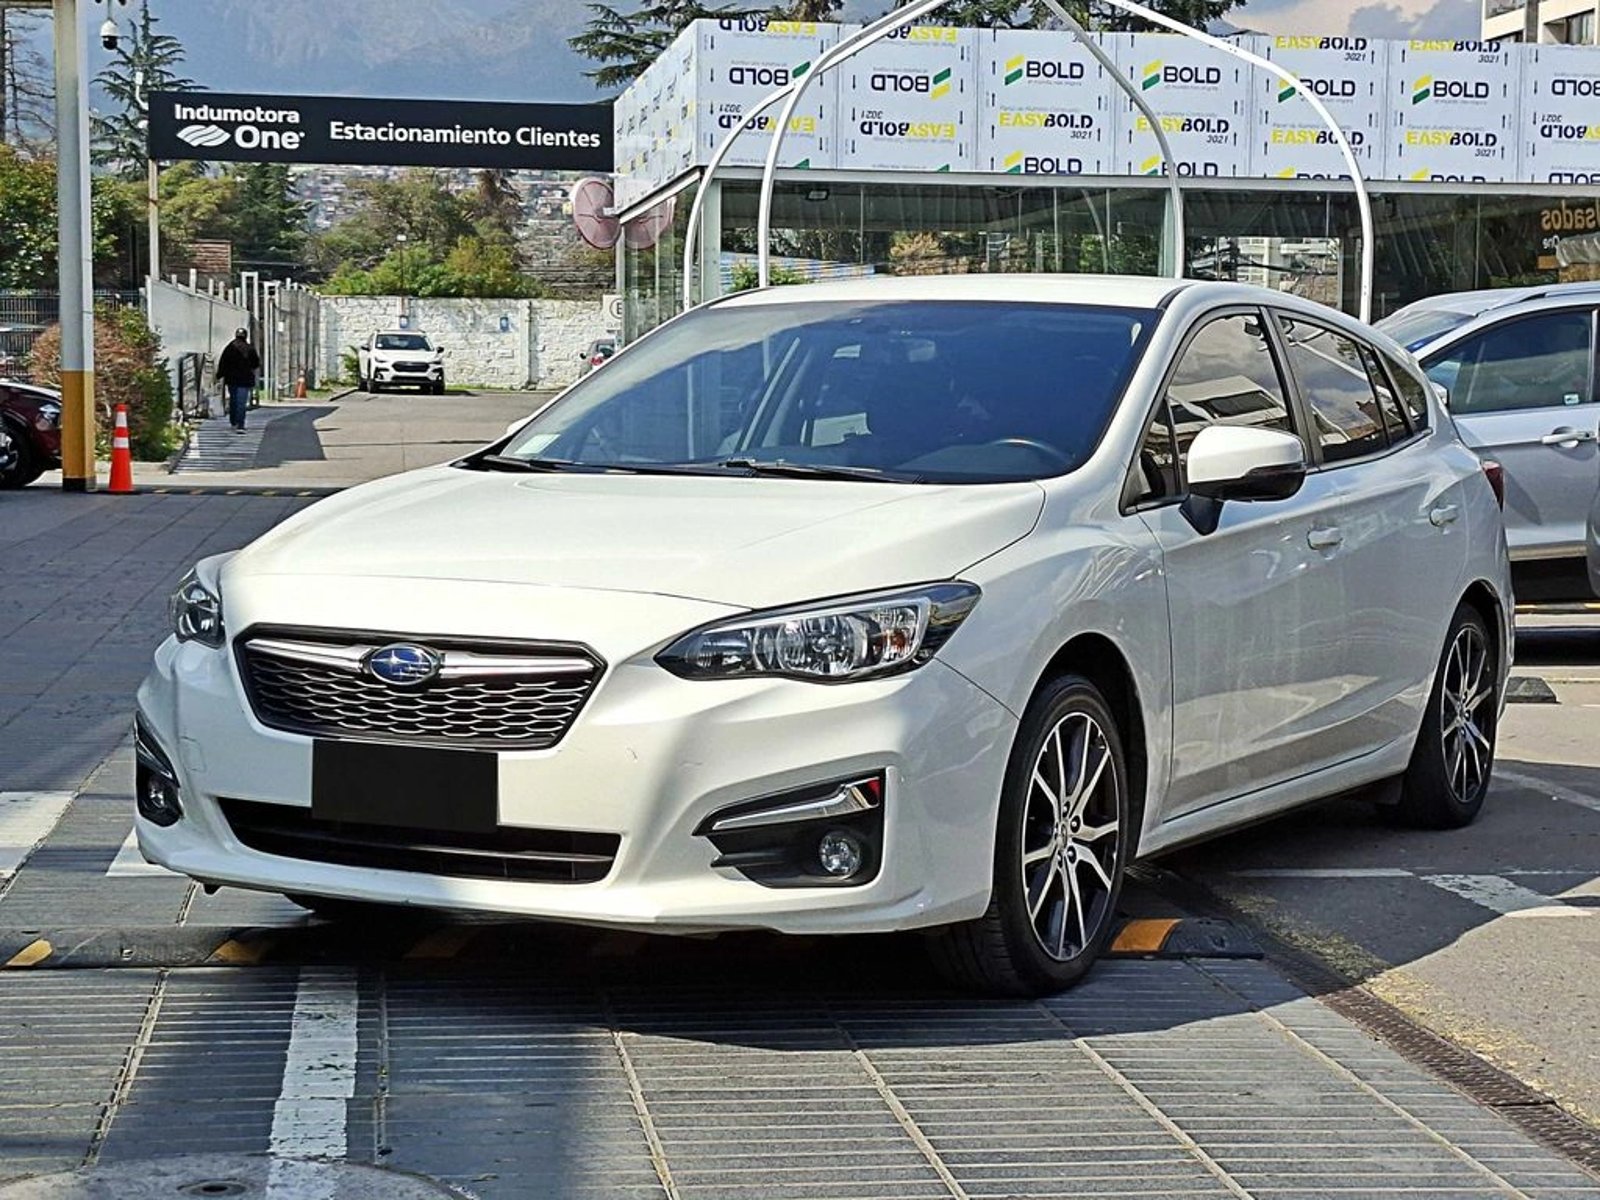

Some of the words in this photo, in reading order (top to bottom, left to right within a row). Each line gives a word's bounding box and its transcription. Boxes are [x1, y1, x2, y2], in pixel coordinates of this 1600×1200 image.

[1275, 36, 1367, 51] EASYBOLD
[1344, 53, 1366, 61] 3021
[1478, 55, 1499, 63] 3021
[729, 67, 789, 86] BOLD
[1026, 61, 1084, 79] BOLD
[1163, 66, 1221, 84] BOLD
[871, 74, 930, 92] BOLD
[1433, 81, 1489, 98] BOLD
[174, 103, 300, 124] Indumotora
[999, 112, 1093, 129] EASYBOLD
[860, 121, 955, 138] EASYBOLD
[1136, 117, 1229, 133] ESYBOLD
[234, 124, 300, 150] One
[329, 121, 511, 145] Estacionamiento
[515, 127, 601, 148] Clientes
[1070, 130, 1092, 139] 3021
[1405, 131, 1498, 147] EASYBOLD
[1474, 148, 1496, 158] 3021
[1024, 157, 1082, 174] BOLD
